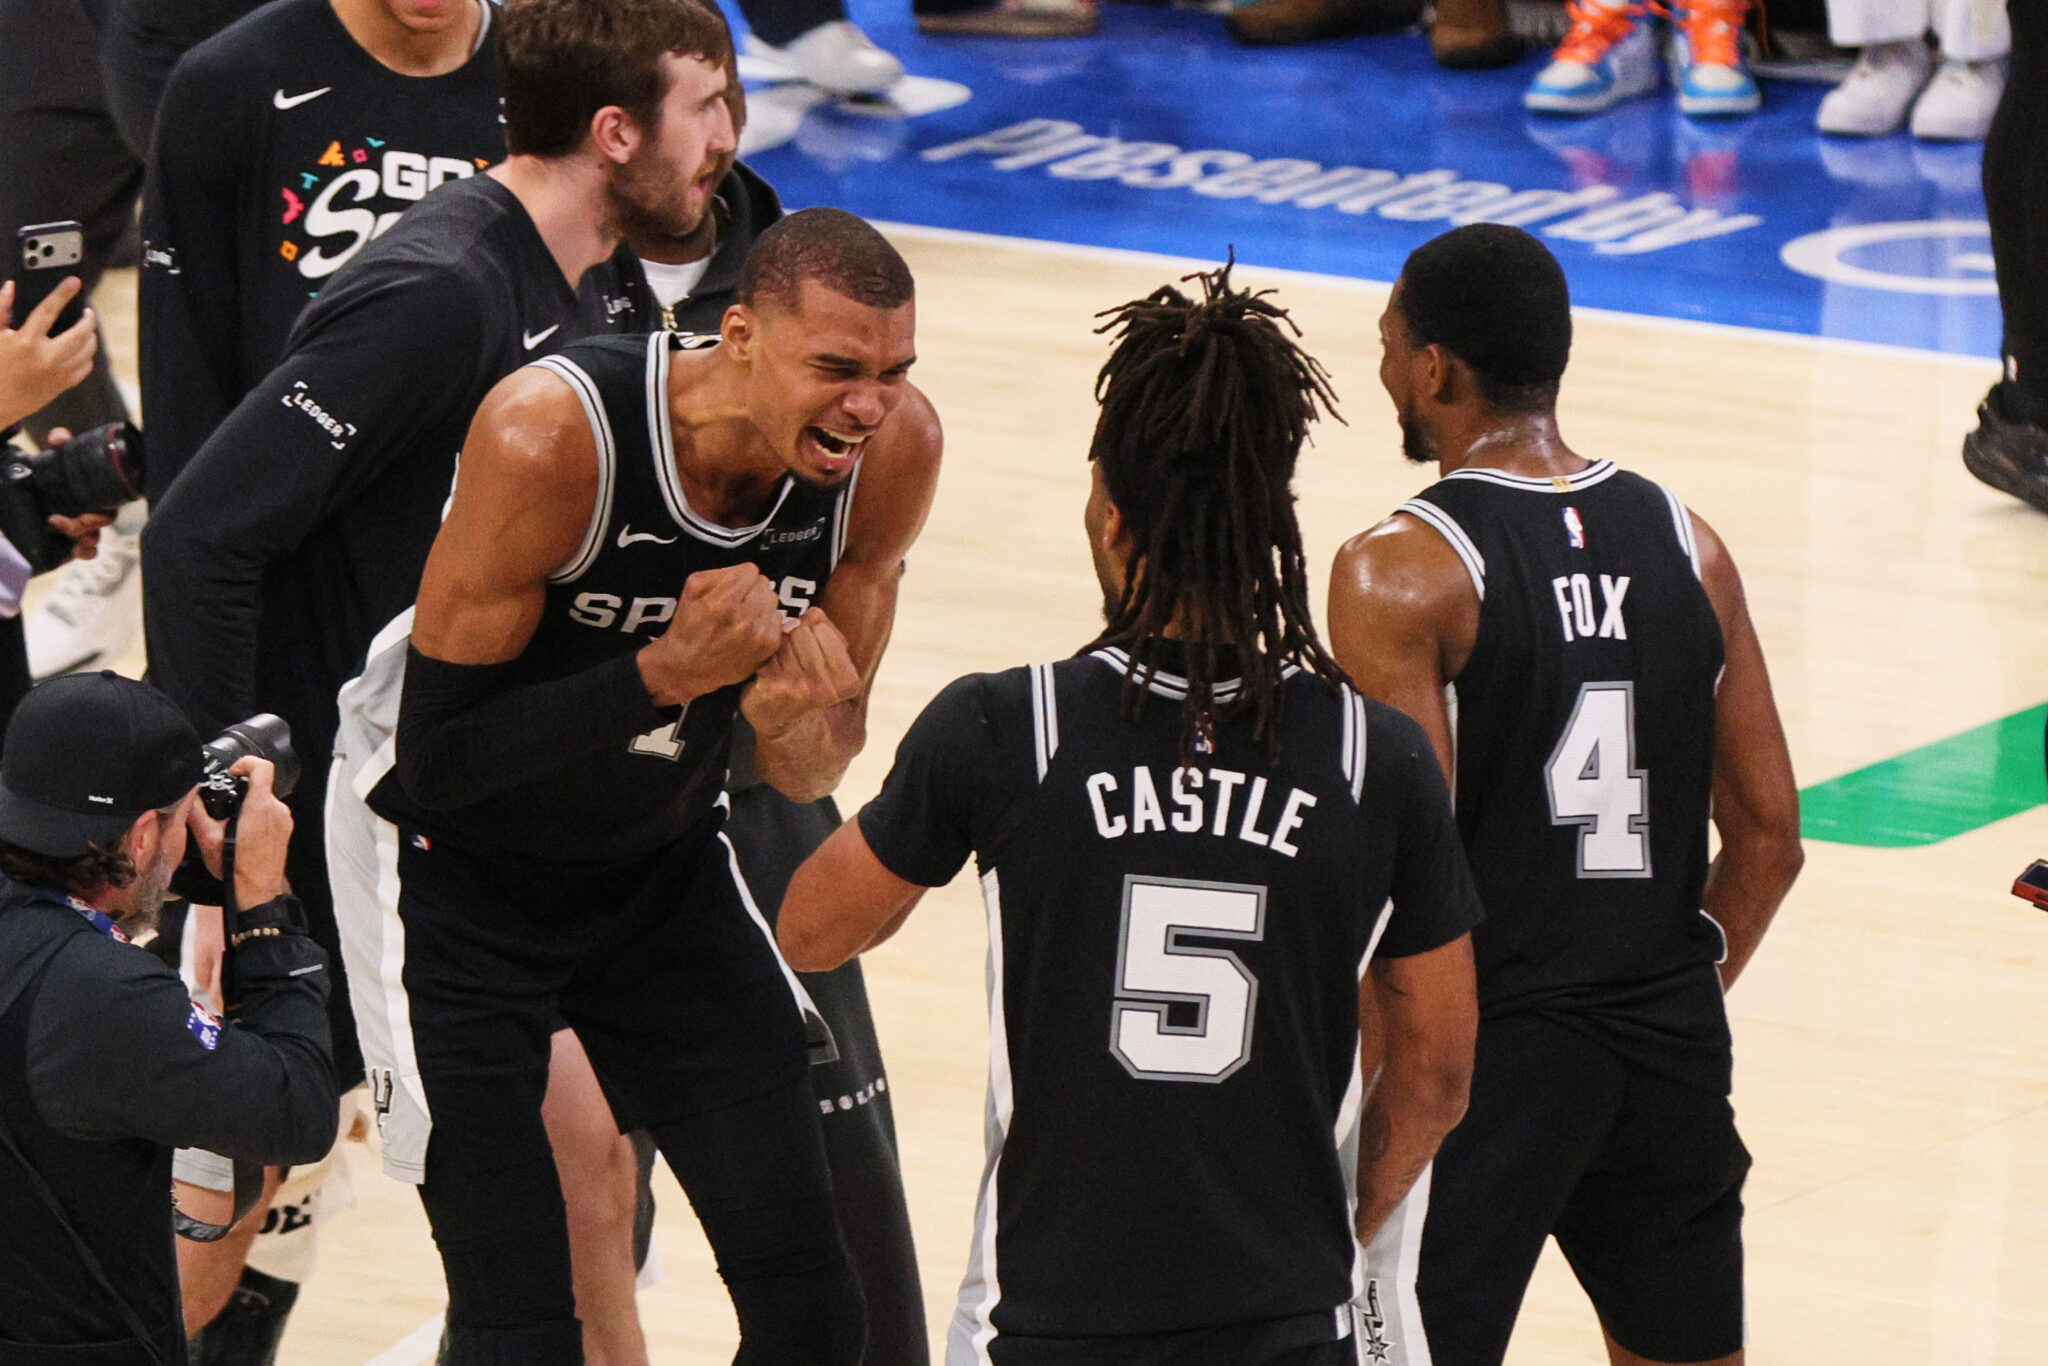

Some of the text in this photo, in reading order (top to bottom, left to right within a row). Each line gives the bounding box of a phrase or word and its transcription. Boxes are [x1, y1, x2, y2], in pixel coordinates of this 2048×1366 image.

[920, 117, 1764, 255] Presented by
[293, 392, 344, 437] LEDGER
[568, 575, 816, 634] SPS
[1553, 574, 1631, 642] FOX
[1086, 766, 1317, 857] CASTLE
[1545, 681, 1653, 878] 4
[1109, 874, 1268, 1084] 5
